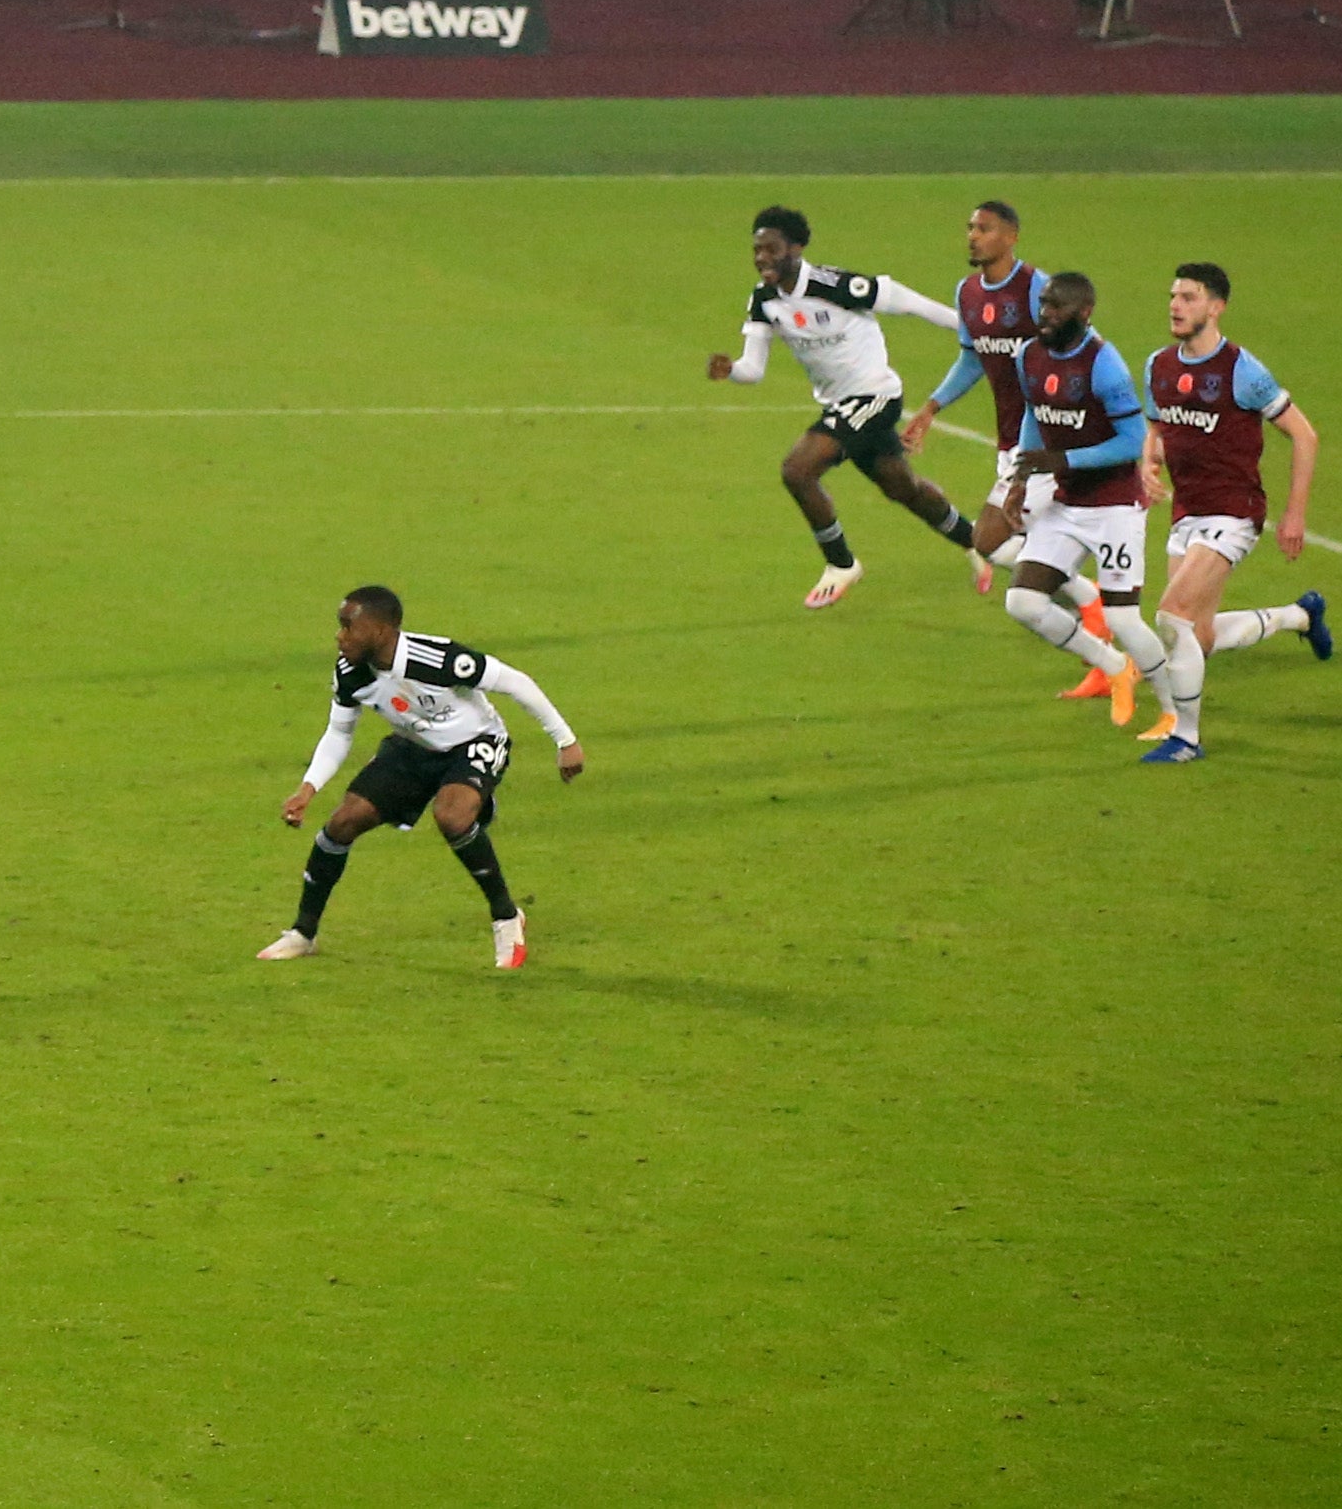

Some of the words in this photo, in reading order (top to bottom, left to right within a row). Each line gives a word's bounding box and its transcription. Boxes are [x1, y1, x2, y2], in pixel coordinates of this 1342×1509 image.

[973, 335, 1023, 358] etway
[1033, 404, 1087, 430] etway
[1099, 543, 1132, 570] 26
